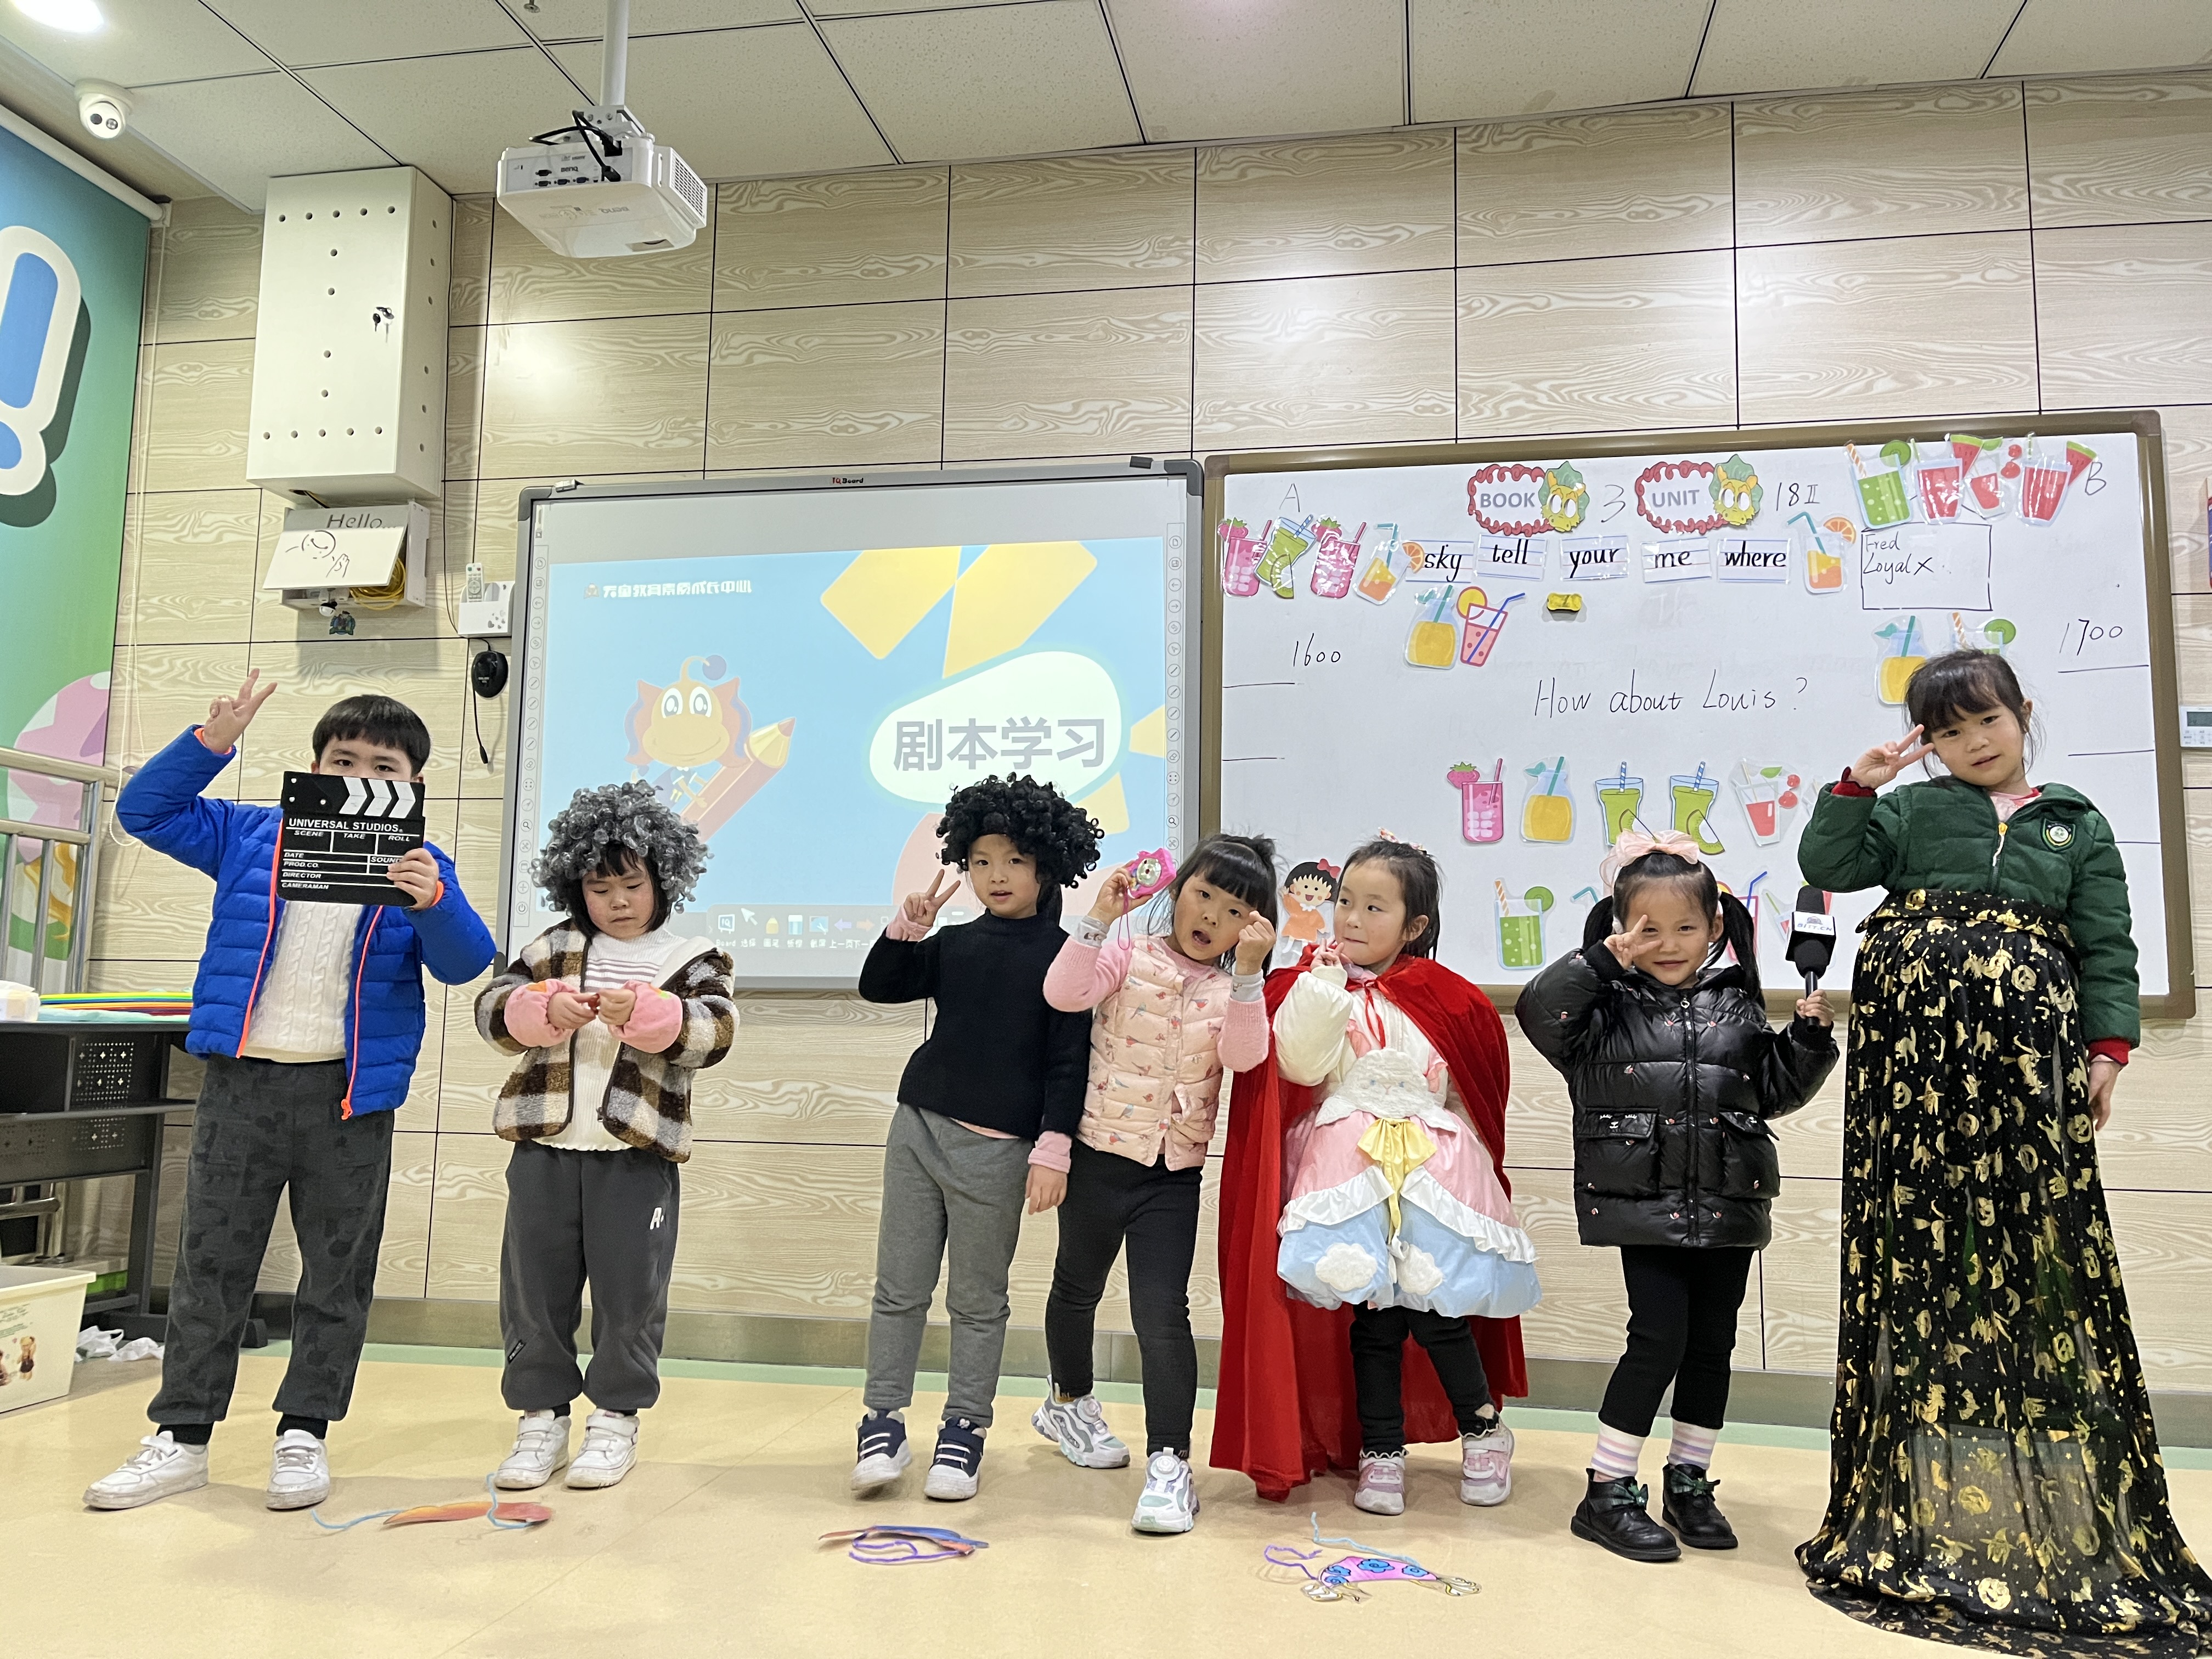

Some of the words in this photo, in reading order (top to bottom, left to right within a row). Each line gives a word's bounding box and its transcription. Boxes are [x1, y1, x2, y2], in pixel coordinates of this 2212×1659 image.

[2084, 461, 2107, 495] B
[1279, 483, 1300, 512] A
[1480, 492, 1535, 509] BOOK
[1601, 484, 1626, 523] 3
[1652, 489, 1700, 508] UNIT
[1492, 539, 1529, 564] tell
[1725, 540, 1787, 567] where
[1865, 534, 1900, 551] Fred
[1424, 541, 1462, 582] sky
[1570, 548, 1618, 575] your
[1654, 550, 1691, 568] me
[1863, 553, 1911, 584] Loyal
[1292, 633, 1341, 667] 1600
[2059, 618, 2123, 656] 1700
[1535, 677, 1591, 718] How
[1610, 669, 1683, 713] about
[893, 716, 1105, 771] 剧本学习
[289, 818, 349, 830] UNIVERSAL
[829, 939, 853, 949] 上一页
